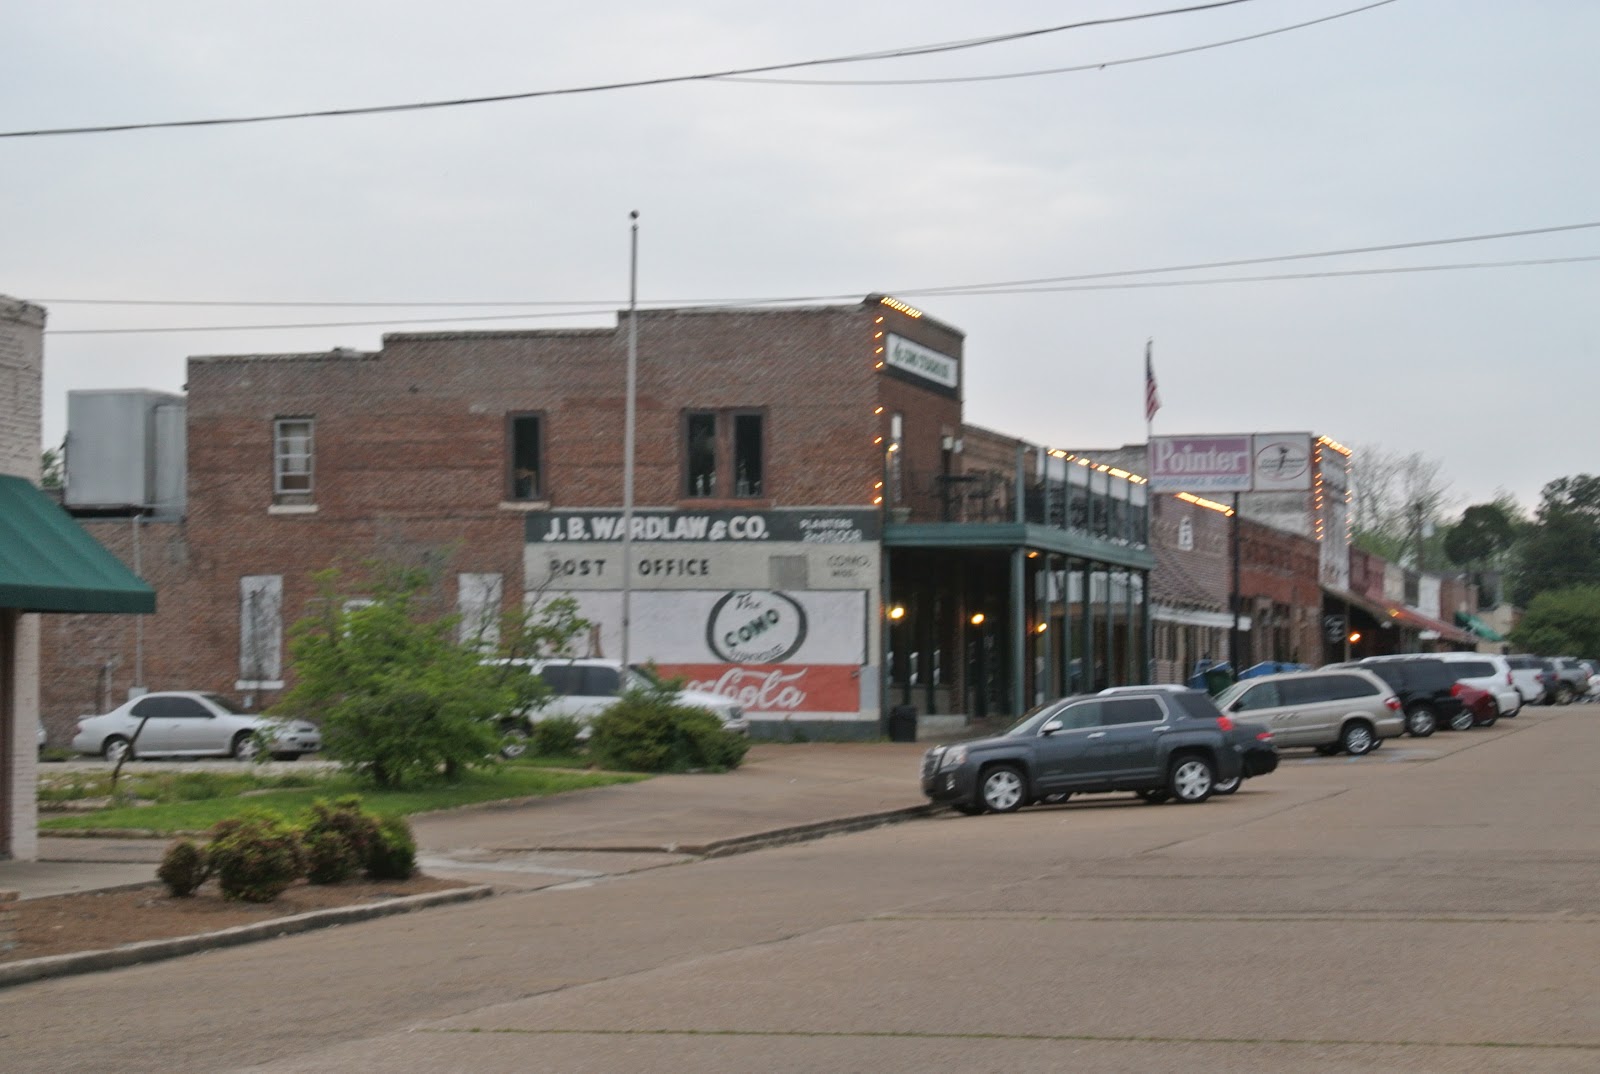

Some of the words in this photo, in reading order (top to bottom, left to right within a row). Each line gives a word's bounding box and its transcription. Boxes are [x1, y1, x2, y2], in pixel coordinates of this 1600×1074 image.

[1153, 439, 1248, 473] Pointer
[708, 519, 727, 541] &
[728, 515, 769, 539] CO.
[550, 559, 606, 577] POST
[638, 558, 710, 577] OFFICE
[724, 608, 780, 649] COMO
